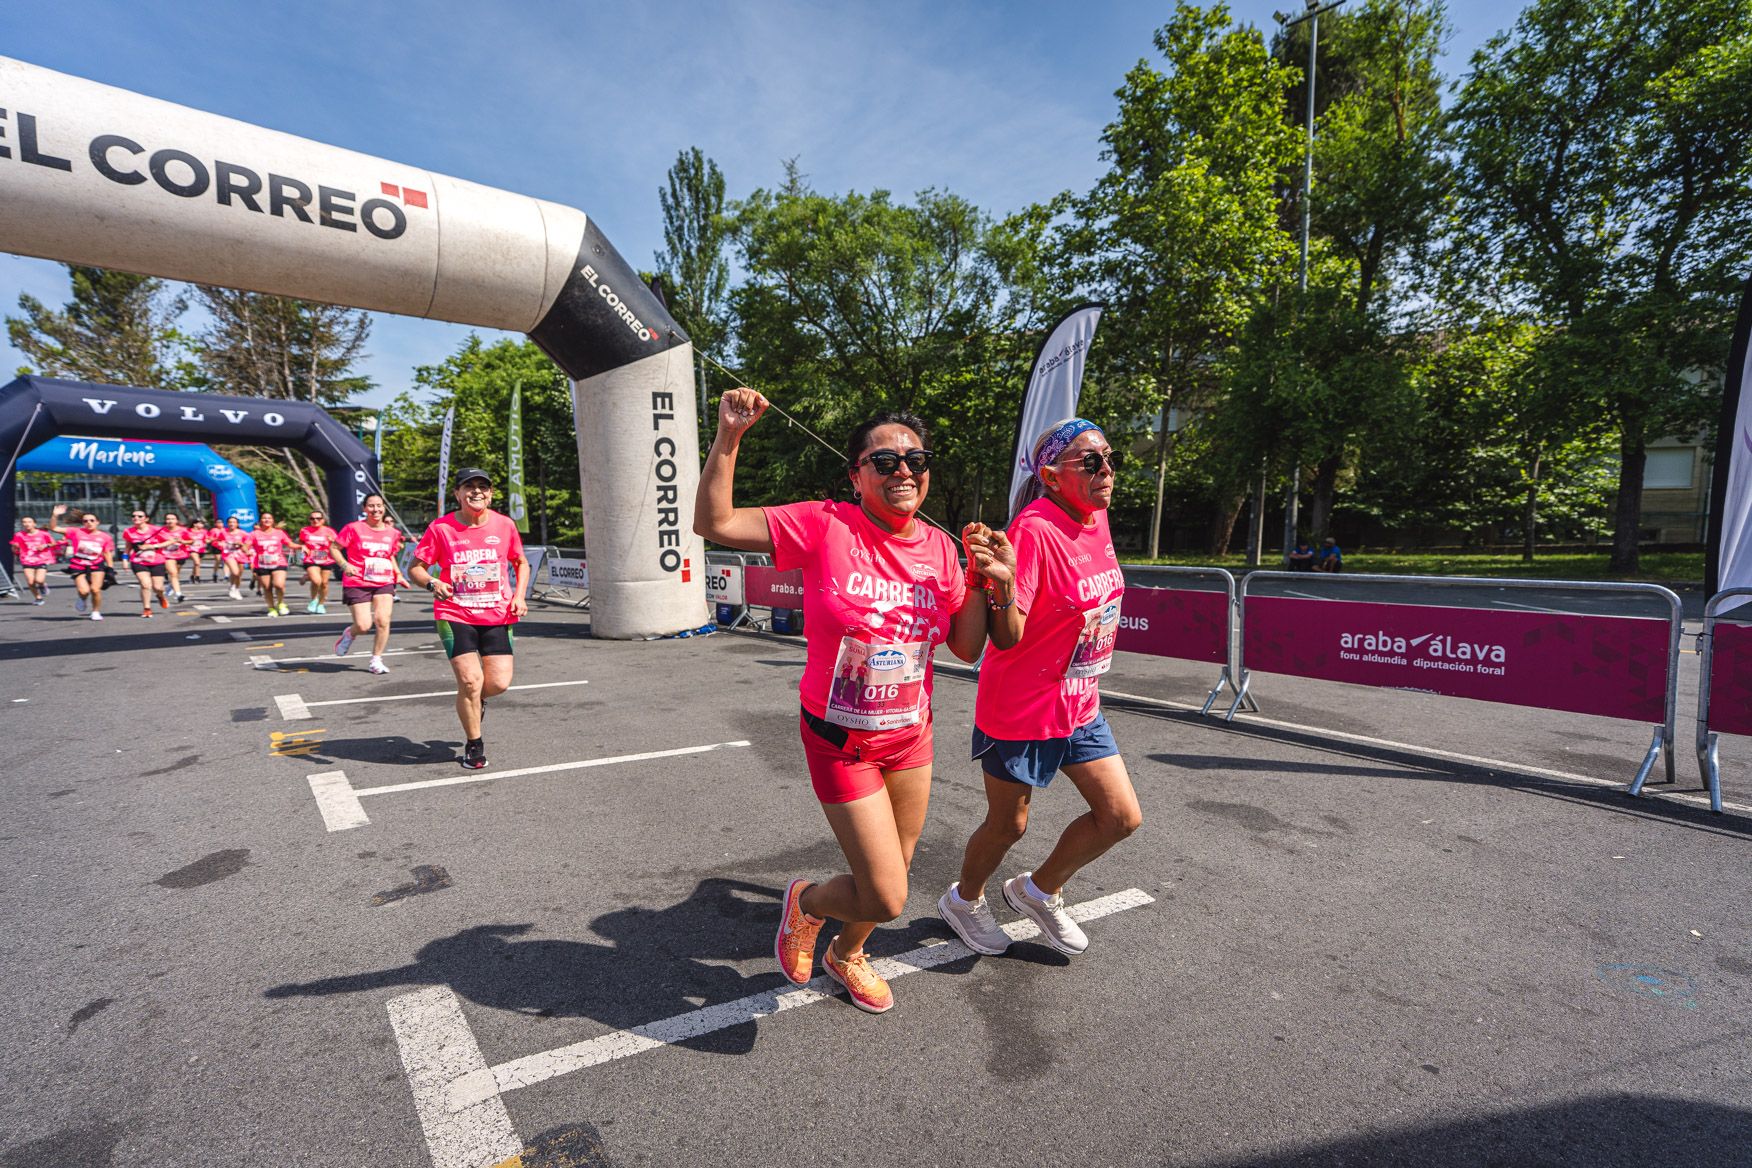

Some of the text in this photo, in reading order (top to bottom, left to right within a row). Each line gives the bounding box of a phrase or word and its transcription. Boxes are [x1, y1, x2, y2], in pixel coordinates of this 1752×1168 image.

[0, 107, 407, 240] L CORREO
[580, 264, 651, 341] EL CORREO
[1039, 356, 1060, 374] araba
[82, 398, 285, 426] VOLVO
[511, 392, 522, 488] AMUTIO
[652, 391, 681, 572] EL CORREO
[453, 548, 498, 563] CARRERA
[1068, 553, 1092, 566] OYSHO
[551, 566, 584, 579] EL CORREO
[467, 581, 486, 589] 016
[706, 575, 727, 591] REO
[771, 583, 804, 594] araba.e
[846, 572, 937, 608] CARRERA
[1120, 616, 1149, 631] eus
[1096, 633, 1113, 650] 016
[1340, 630, 1506, 663] araba álava
[869, 657, 904, 667] ASTURIANA
[1340, 651, 1505, 676] foru aldundia diputación foral
[864, 684, 899, 700] 016
[831, 703, 853, 713] CARRERA
[837, 714, 869, 726] OYSHO
